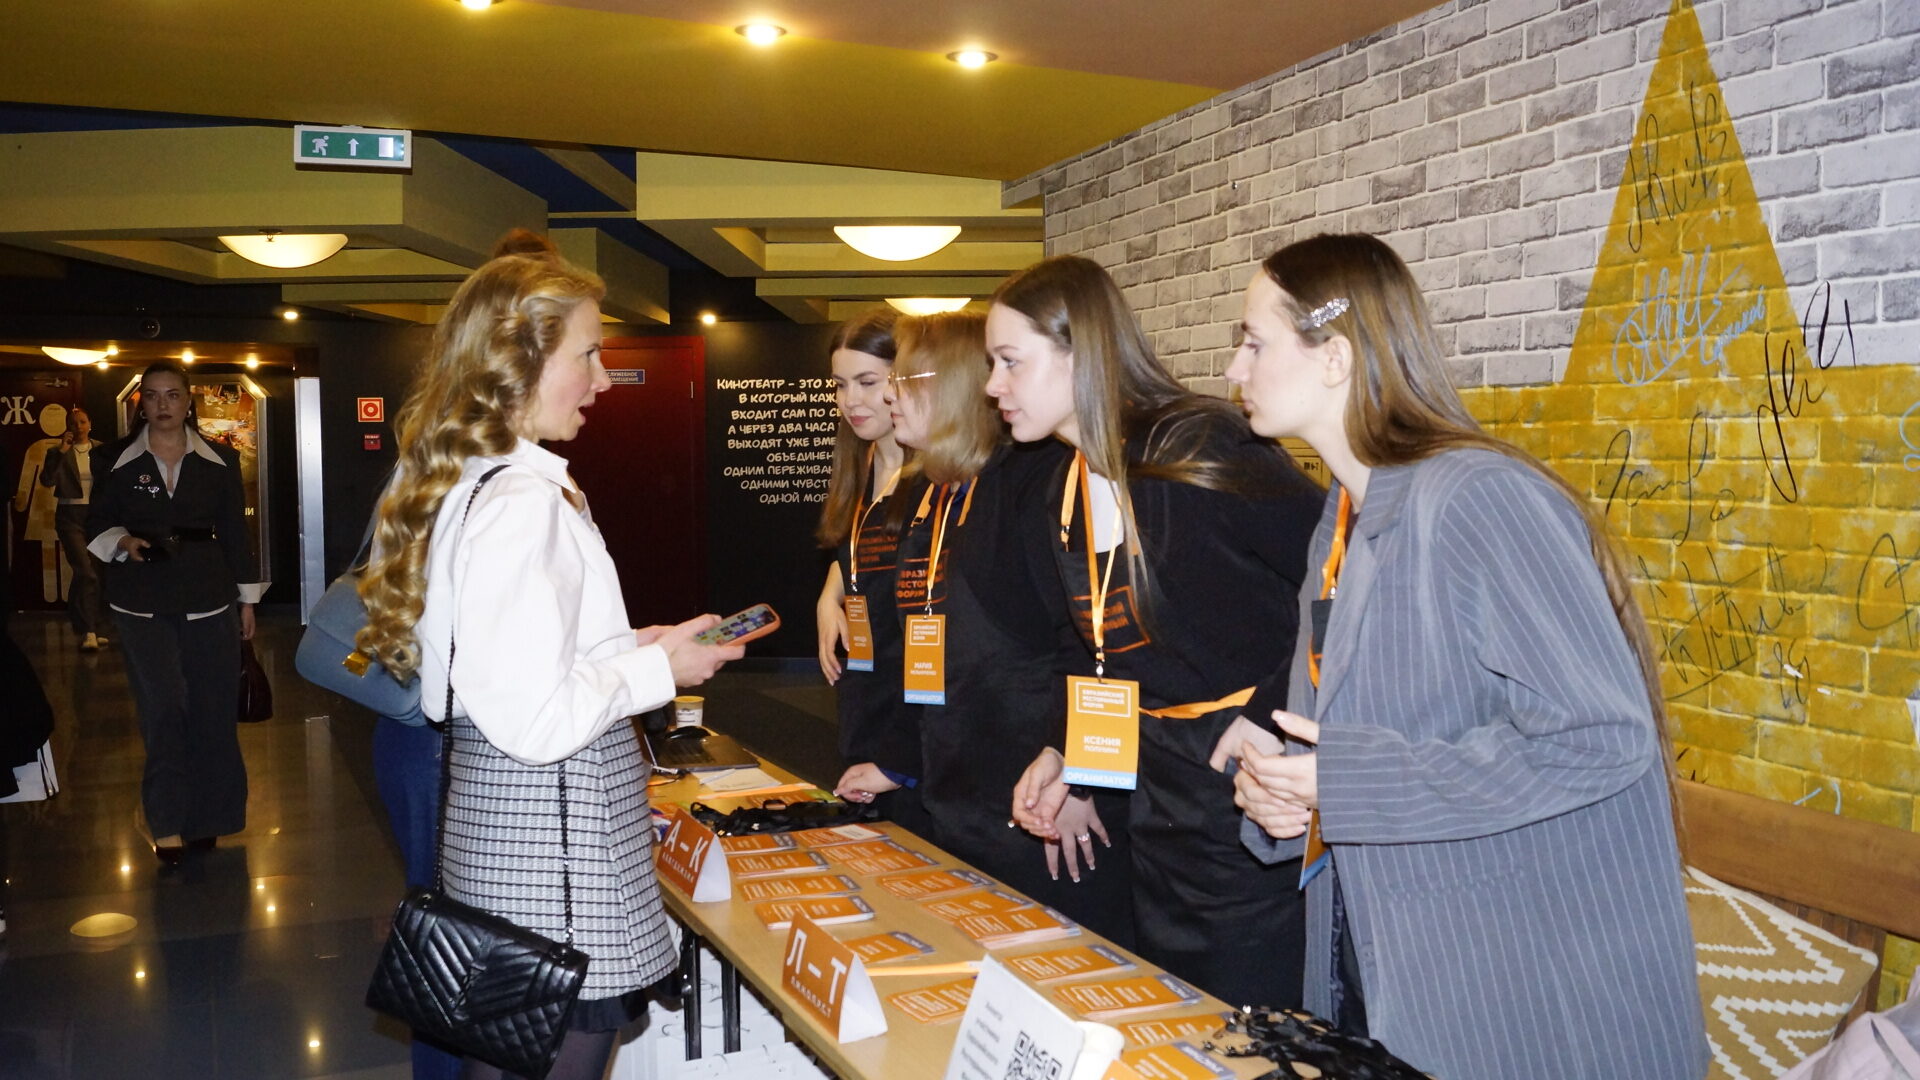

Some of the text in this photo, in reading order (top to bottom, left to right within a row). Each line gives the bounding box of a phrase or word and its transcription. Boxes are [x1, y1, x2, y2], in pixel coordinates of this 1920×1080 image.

[717, 379, 785, 390] КИНОТЕАТР
[799, 379, 822, 389] ЭТО
[739, 393, 748, 404] В
[750, 391, 807, 404] КОТОРЫЙ
[1, 396, 36, 425] Ж
[731, 409, 778, 420] ВХОДИТ
[782, 408, 806, 419] САМ
[809, 408, 825, 418] ПО
[728, 422, 835, 435] А ЧЕРЕЗ ДВА ЧАСА
[727, 439, 782, 450] ВЫХОДЯТ
[786, 437, 810, 448] УЖЕ
[723, 466, 764, 477] ОДНИМ
[740, 479, 789, 490] ОДНИМИ
[760, 492, 800, 505] ОДНОЙ
[1083, 735, 1121, 747] КСЕНИЯ
[1066, 771, 1133, 786] ОРГАНИЗАТОР
